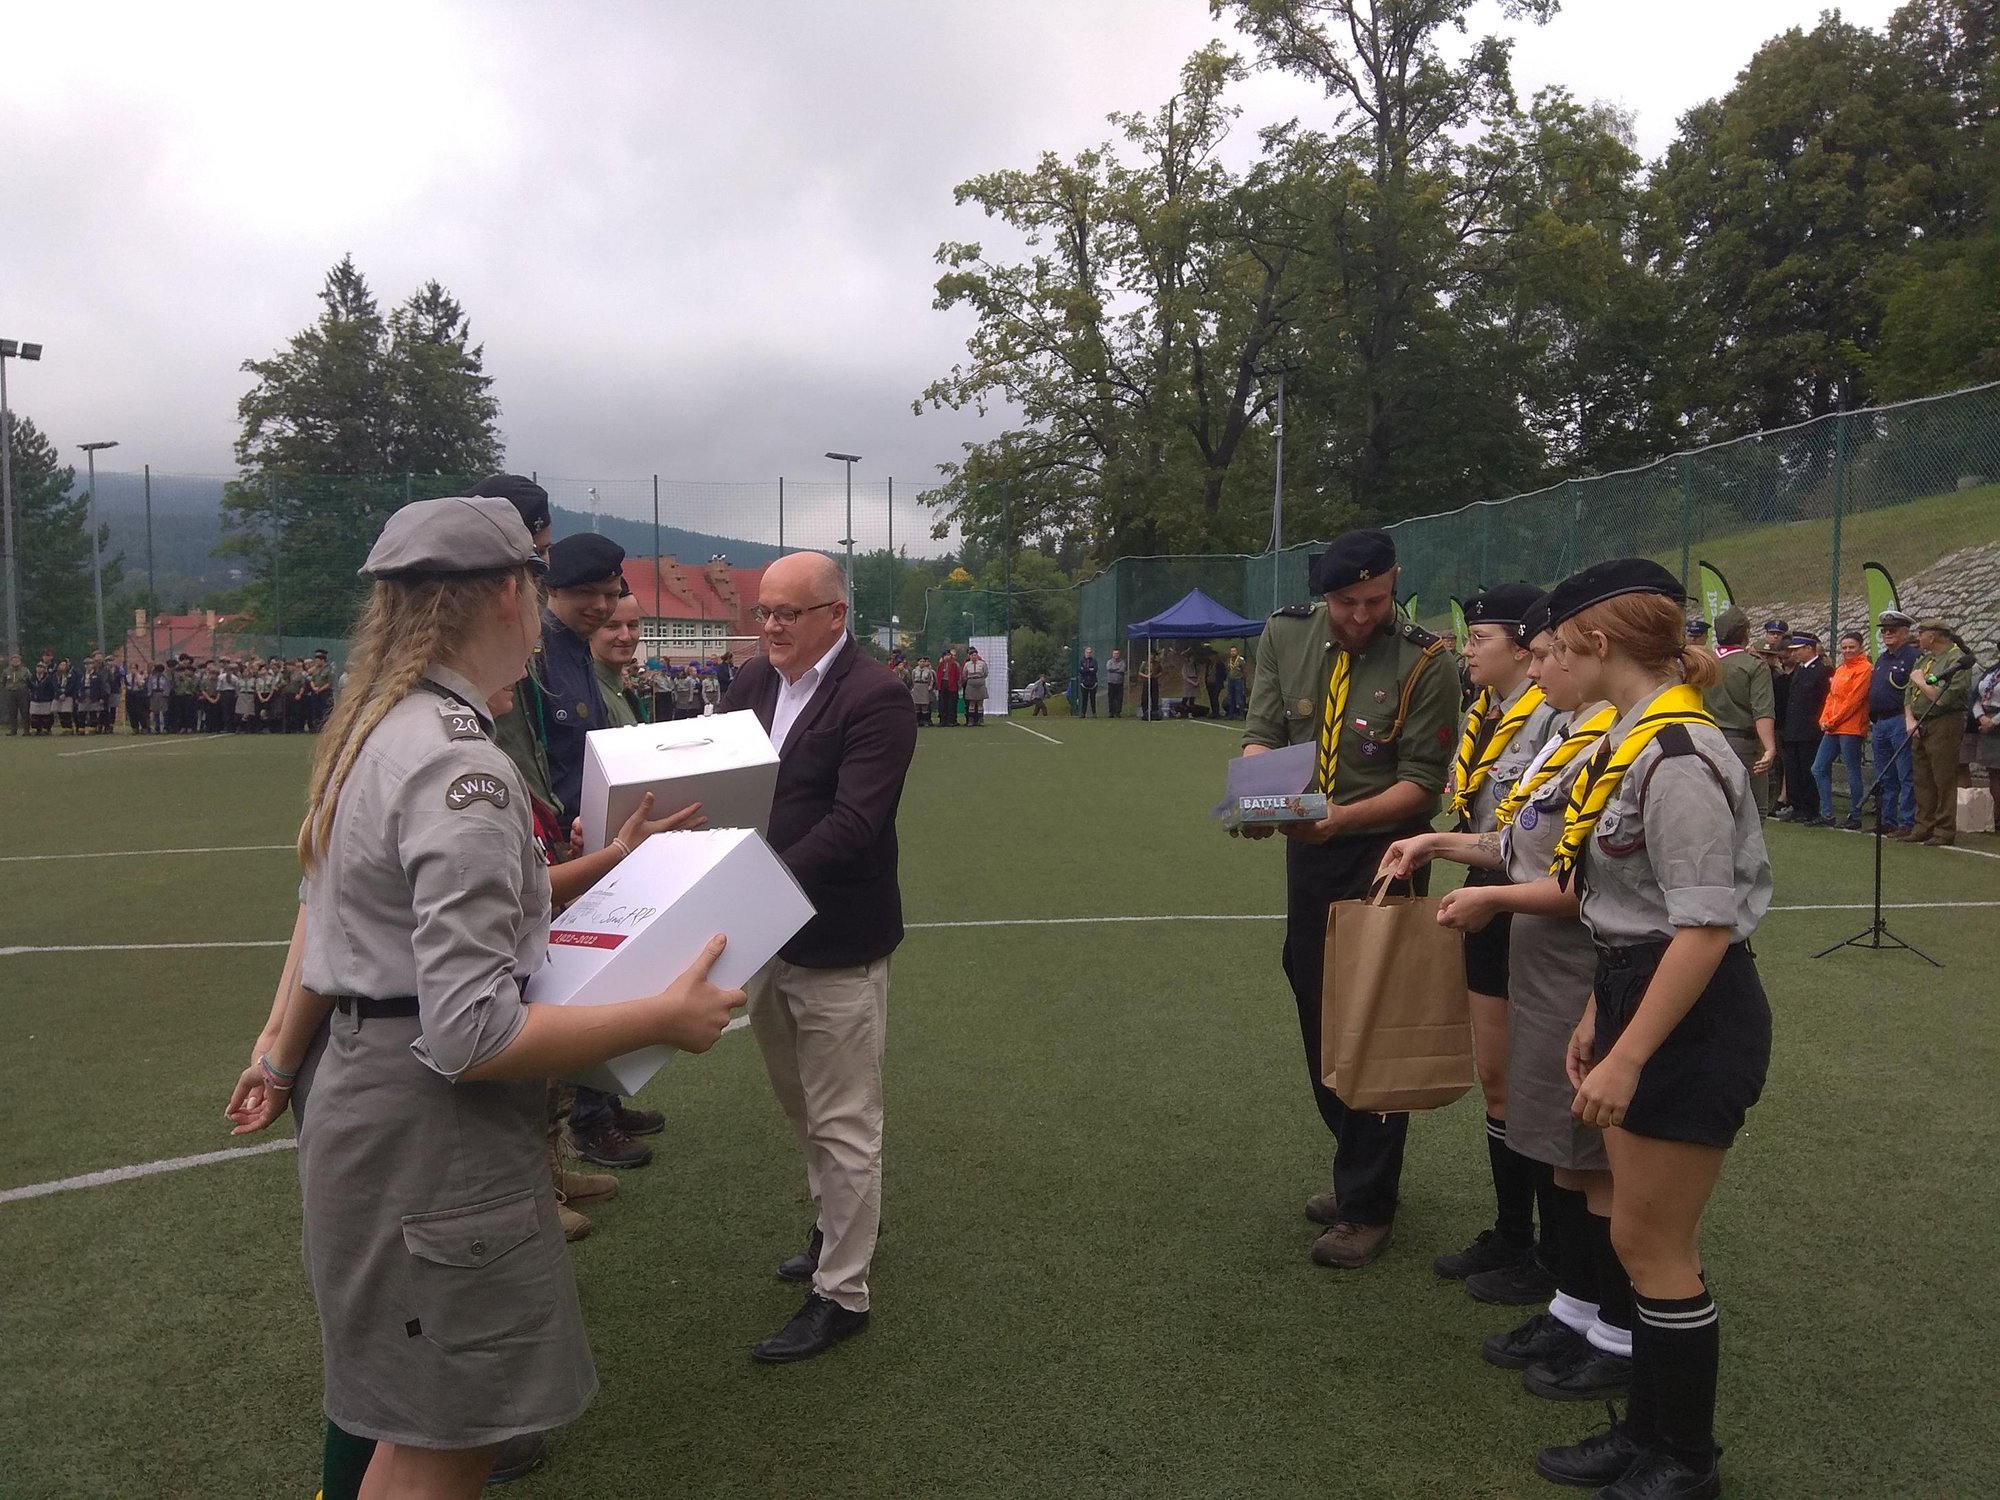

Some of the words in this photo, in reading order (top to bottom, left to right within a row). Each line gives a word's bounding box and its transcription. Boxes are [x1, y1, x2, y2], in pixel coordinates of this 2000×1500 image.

[453, 717, 479, 733] 20
[449, 779, 506, 803] KWISA
[1244, 798, 1287, 810] BATTLE
